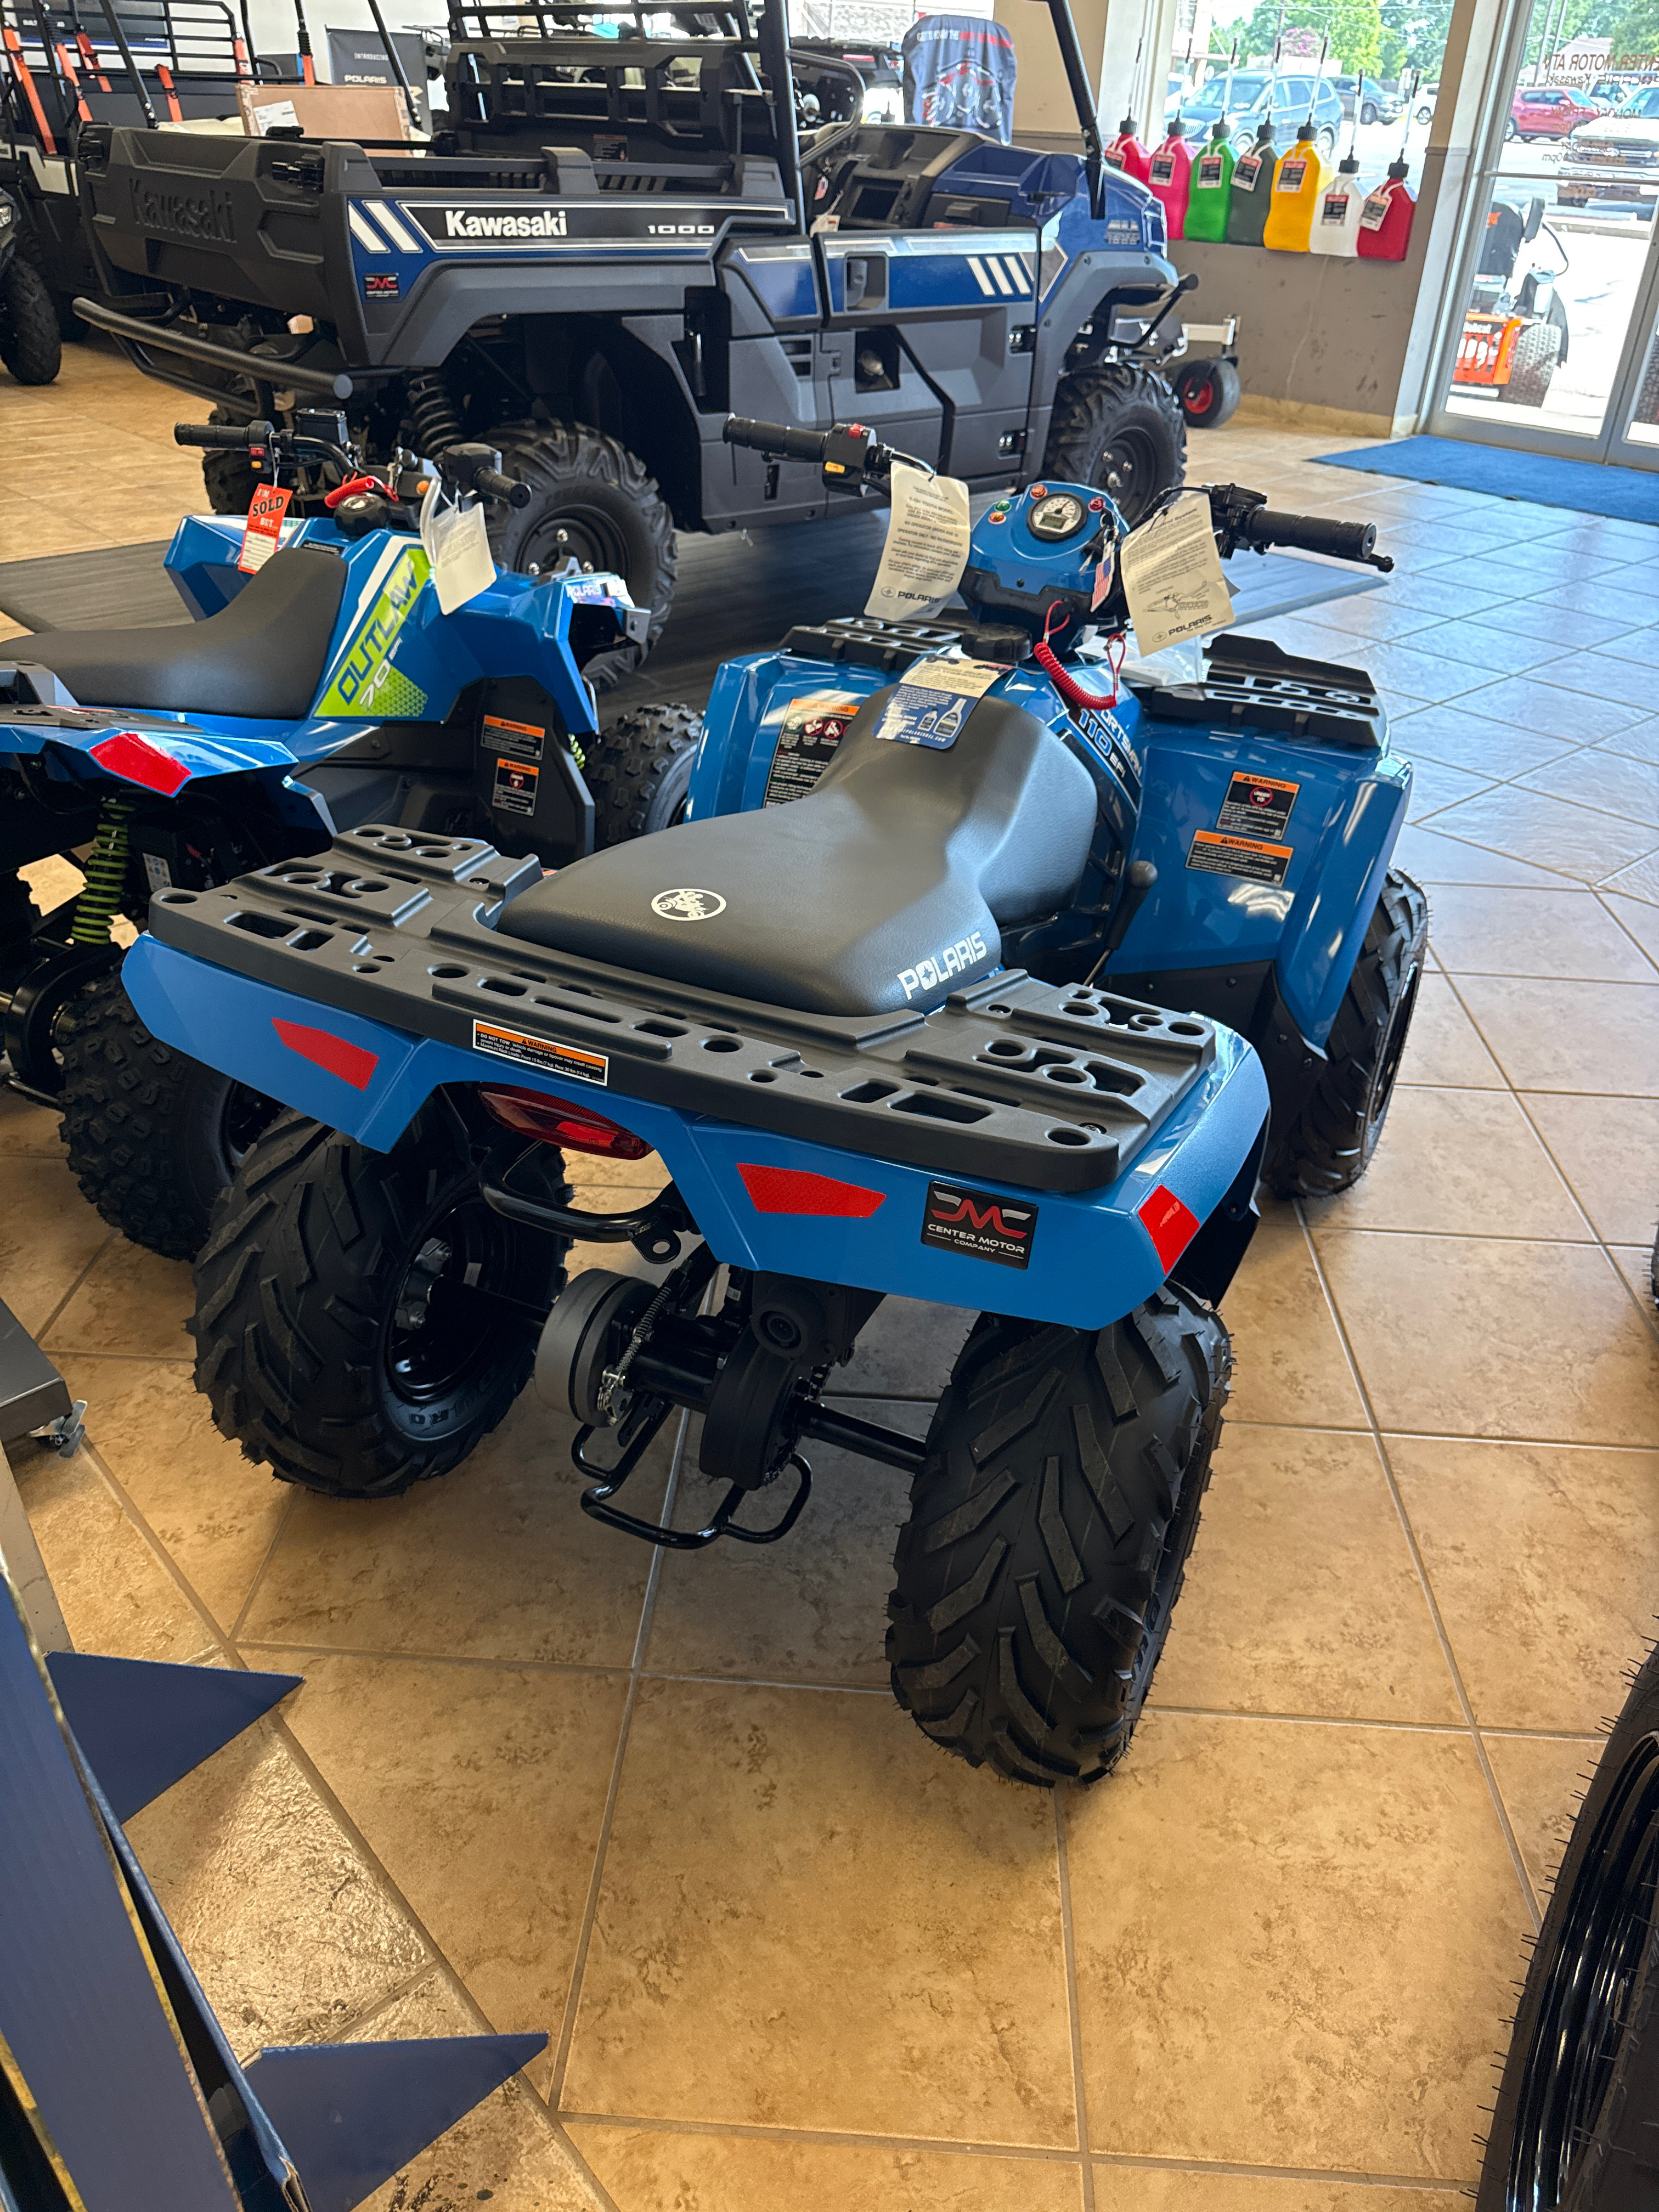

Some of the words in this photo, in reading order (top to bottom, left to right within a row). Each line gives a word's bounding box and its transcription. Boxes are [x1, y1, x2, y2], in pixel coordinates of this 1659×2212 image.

[344, 75, 387, 84] POLARIS
[128, 178, 237, 244] Kawasaki
[445, 211, 567, 236] Kawasaki
[647, 225, 715, 234] 1000
[252, 496, 284, 517] SOLD
[1174, 508, 1197, 521] System
[896, 527, 918, 536] OPERATOR
[910, 521, 932, 530] OPERATOR
[337, 558, 417, 706] OUTLAW
[1168, 614, 1213, 636] POLARIS
[359, 658, 391, 707] 70
[820, 704, 849, 712] WARNING
[505, 723, 527, 731] WARNING
[1079, 708, 1113, 757] 110
[1109, 752, 1126, 778] EFI
[1100, 709, 1143, 777] ORTSMAN
[1251, 776, 1286, 789] WARNING
[1227, 839, 1263, 850] WARNING
[896, 931, 987, 1000] POLARIS
[479, 1042, 499, 1051] Maximum
[527, 1040, 557, 1053] WARNING
[511, 1042, 527, 1050] Vehicle
[526, 1047, 544, 1056] damage
[585, 1064, 602, 1073] causing
[928, 1223, 976, 1241] CENTER
[978, 1237, 1025, 1254] MOTOR
[954, 1239, 996, 1253] COMPANY
